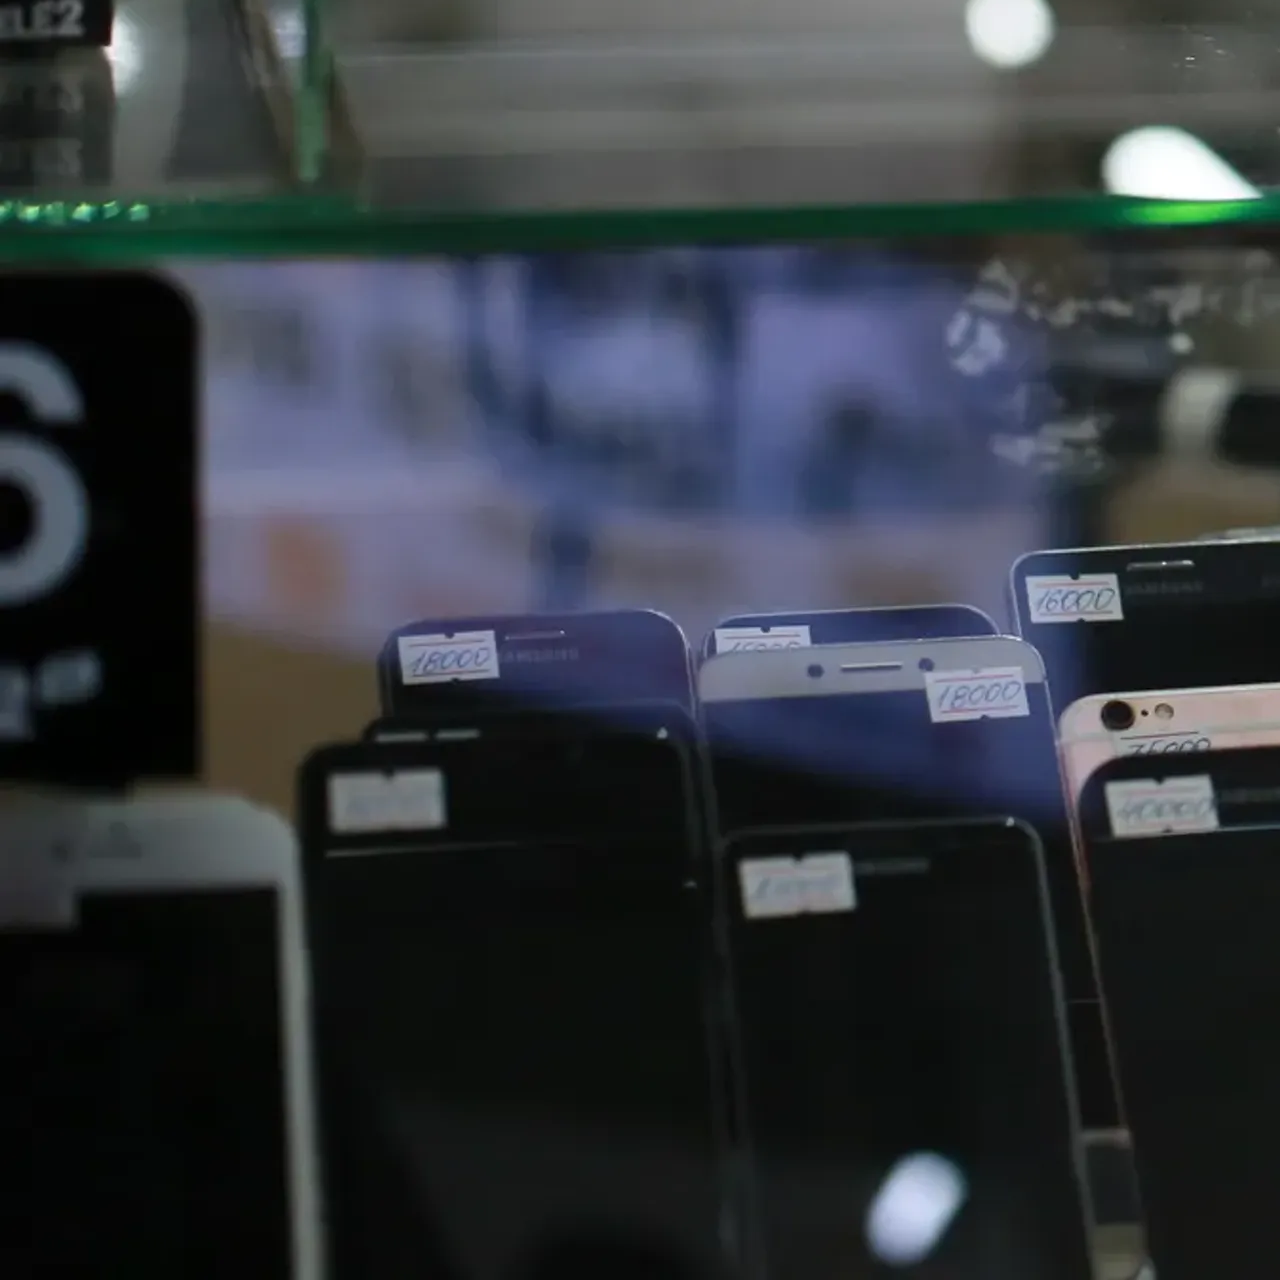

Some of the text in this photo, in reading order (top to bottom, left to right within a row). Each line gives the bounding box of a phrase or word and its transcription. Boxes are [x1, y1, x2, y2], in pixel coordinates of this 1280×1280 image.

[1036, 588, 1116, 612] 16000
[410, 647, 491, 675] 18000
[939, 680, 1021, 710] 18000
